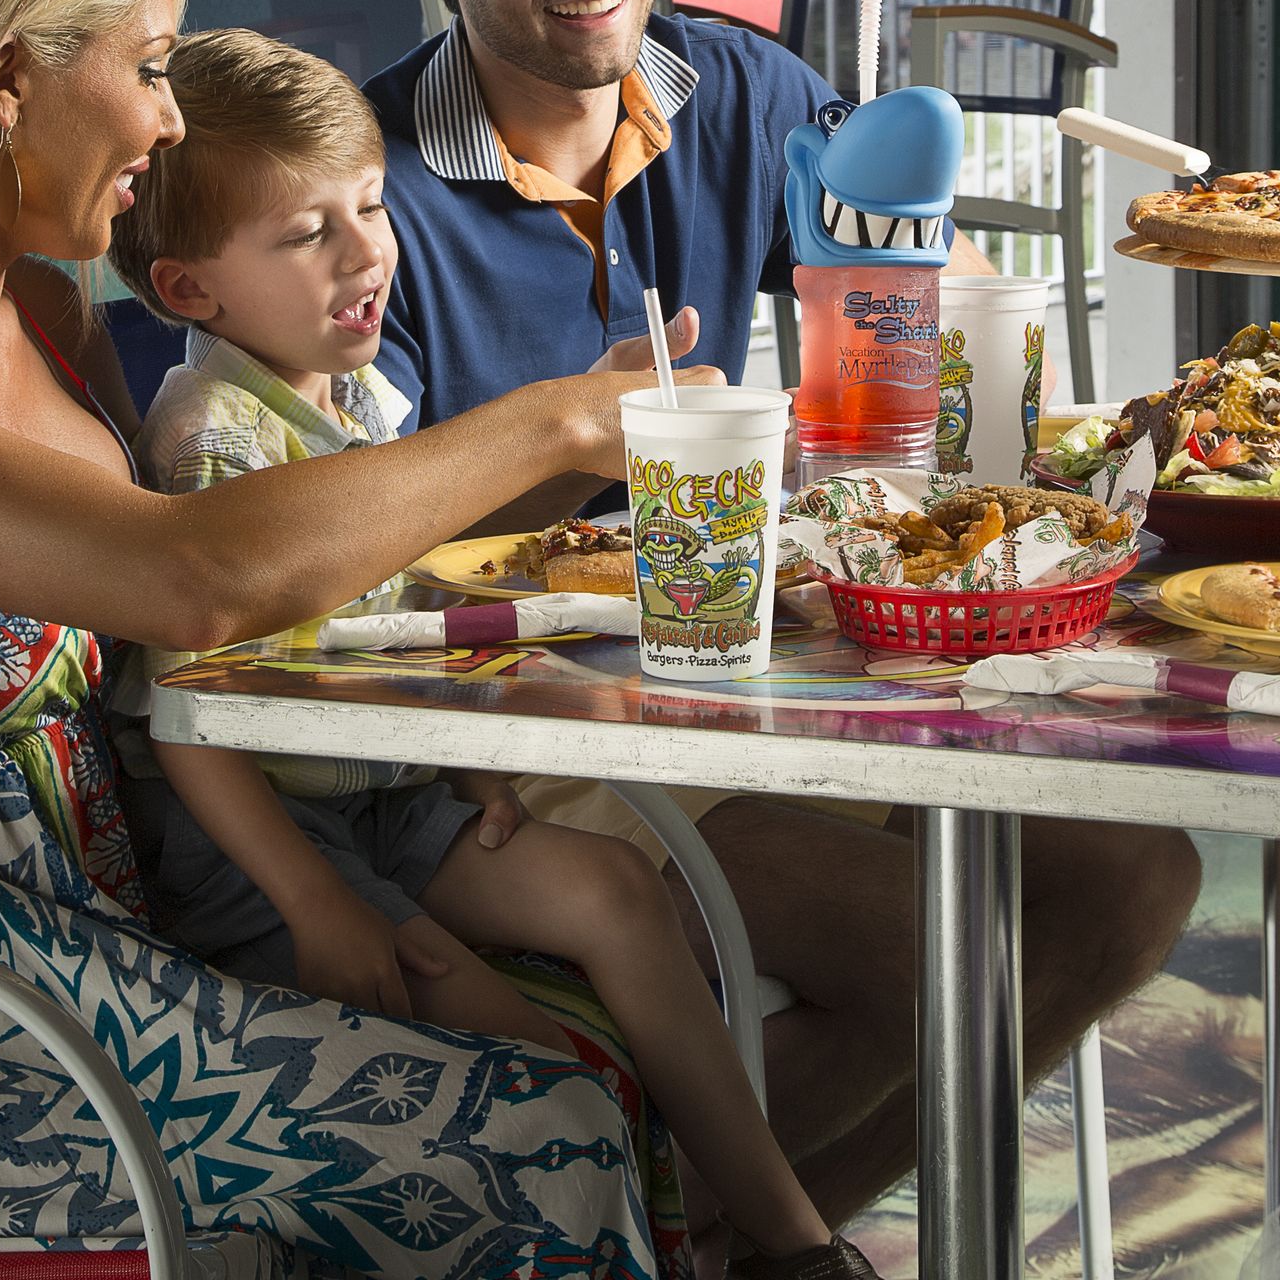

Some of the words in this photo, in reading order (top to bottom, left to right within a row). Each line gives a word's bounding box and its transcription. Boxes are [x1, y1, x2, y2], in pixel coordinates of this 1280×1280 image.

[843, 291, 920, 319] Salty
[854, 319, 875, 330] the
[874, 316, 938, 345] Shark
[839, 346, 885, 357] Vacation
[668, 460, 765, 523] GECKO
[641, 620, 700, 652] Restaurant
[701, 624, 716, 649] &
[716, 620, 760, 652] Cantina
